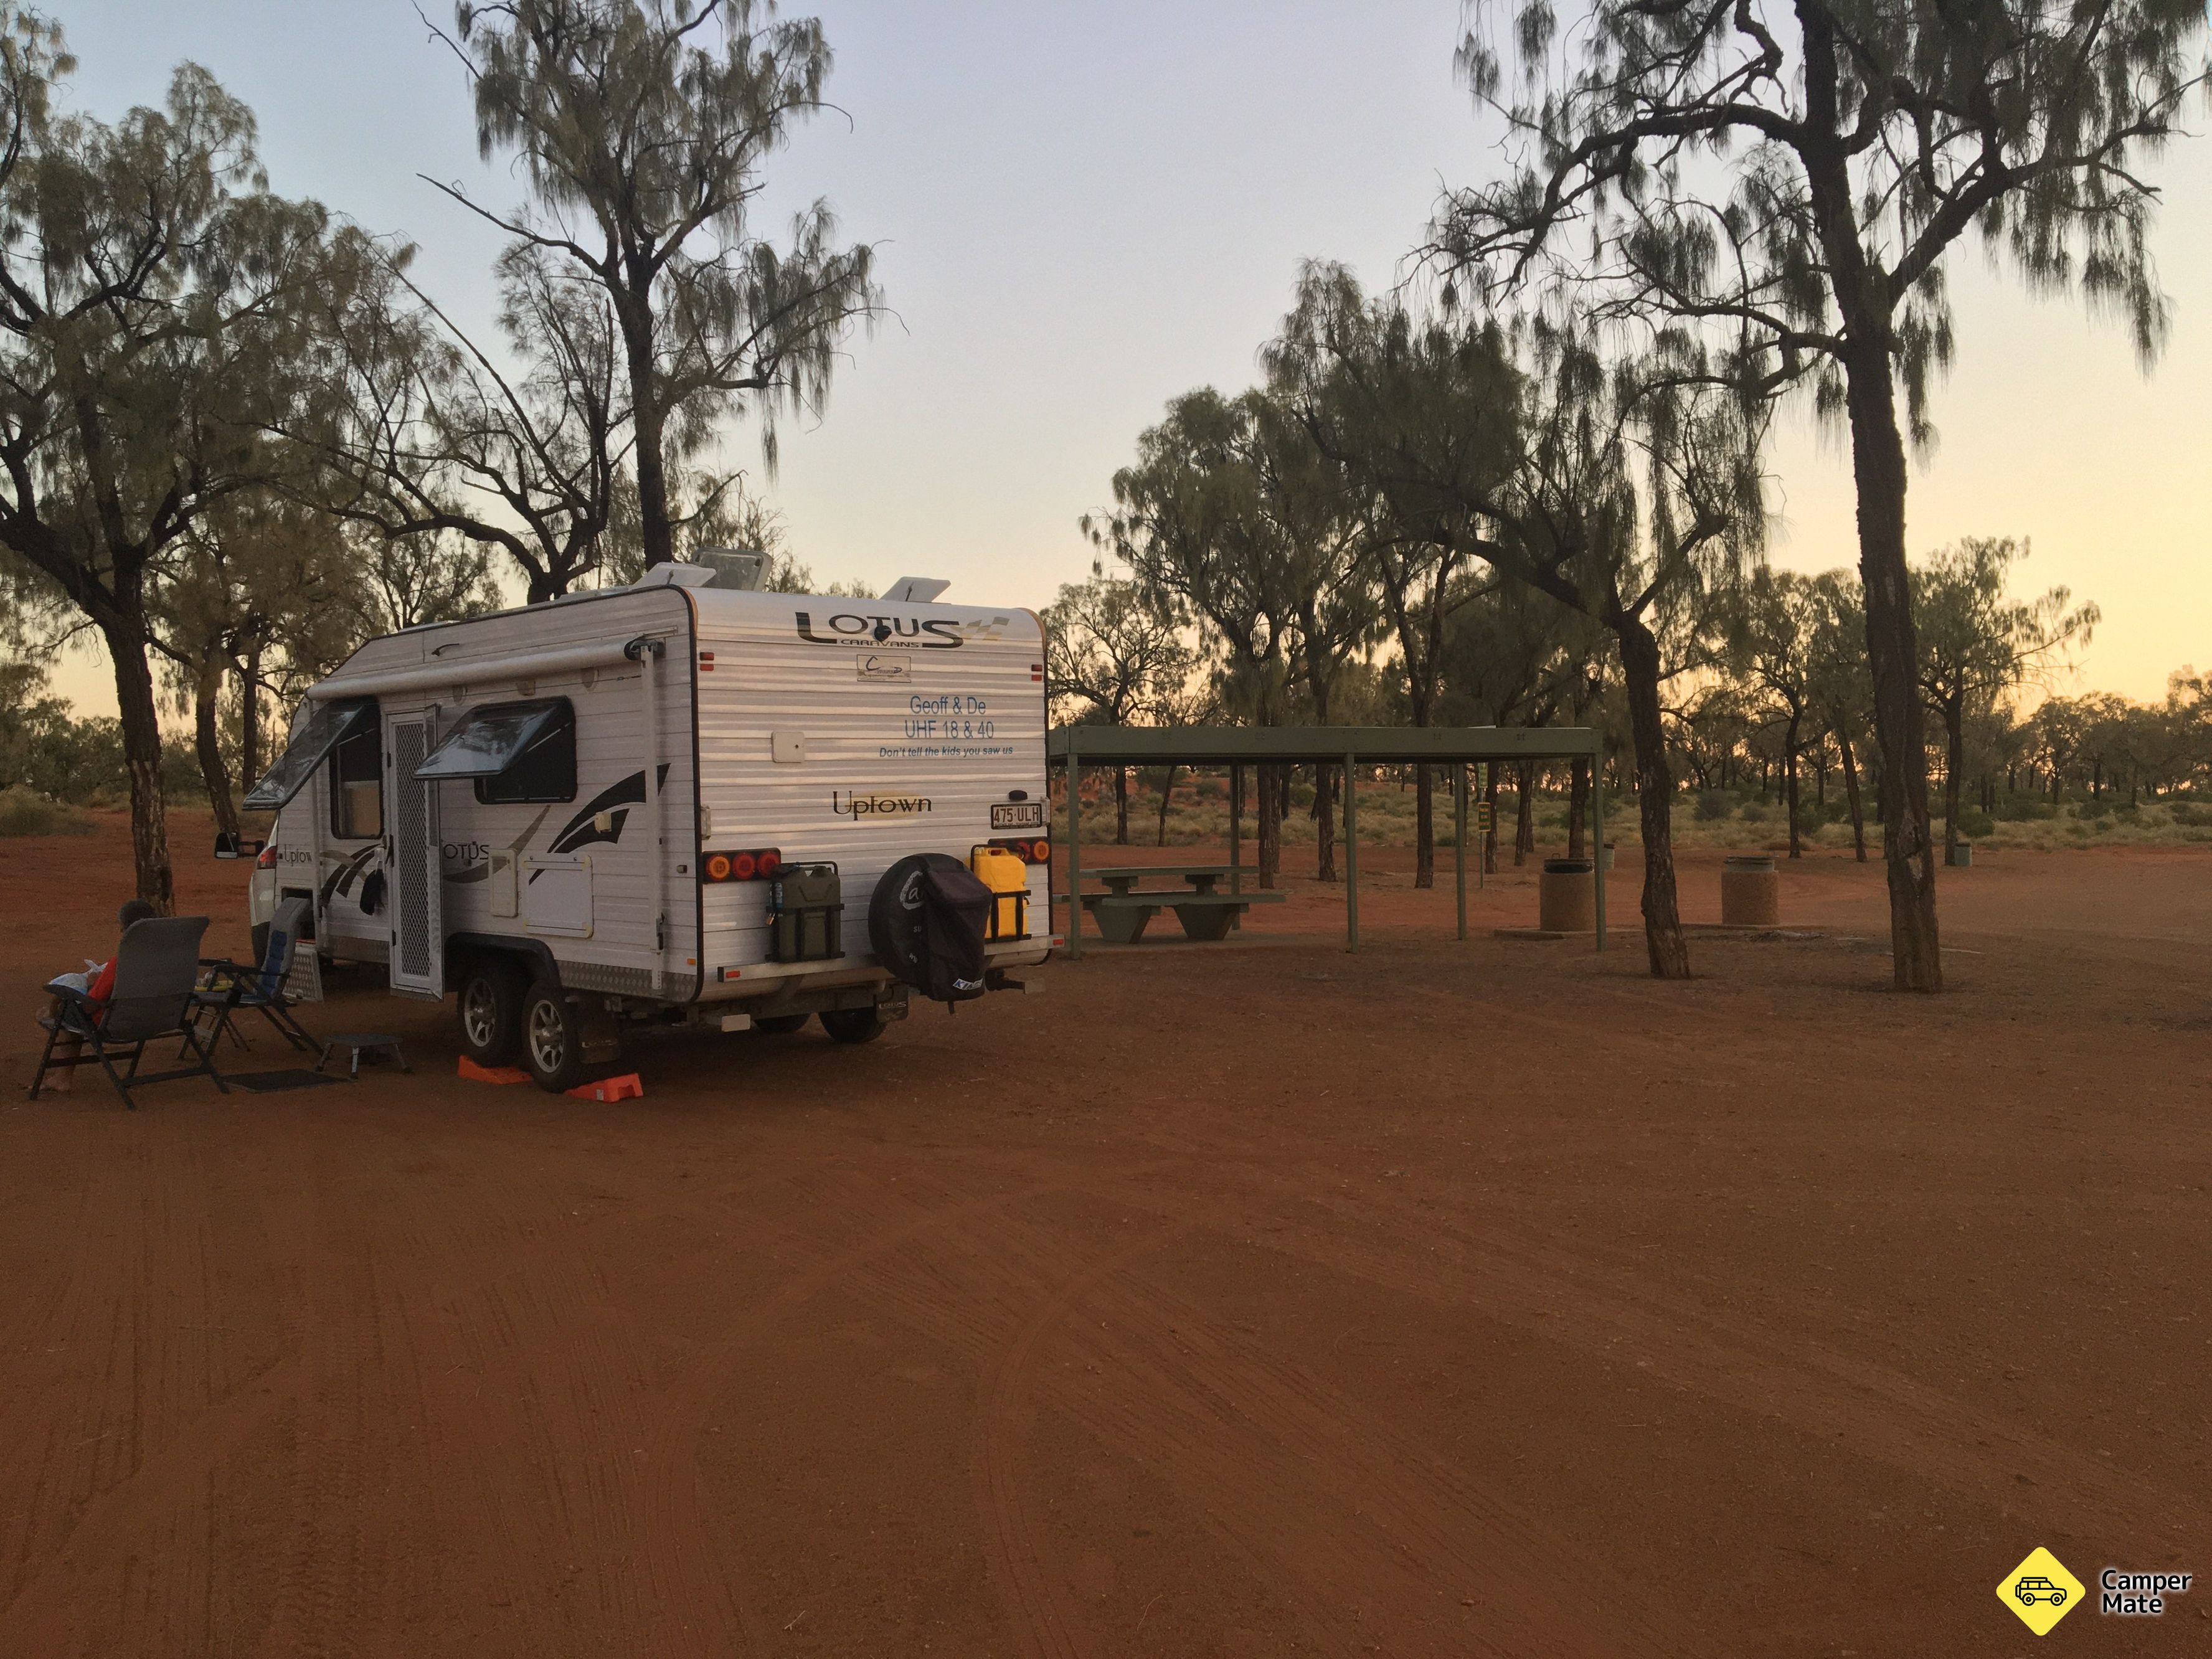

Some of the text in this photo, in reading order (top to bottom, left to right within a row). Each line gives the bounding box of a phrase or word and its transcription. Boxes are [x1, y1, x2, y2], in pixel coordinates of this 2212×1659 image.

[795, 612, 963, 648] LOTUS
[841, 639, 919, 648] CARAVANS
[910, 696, 986, 715] Geoff & De
[905, 720, 995, 739] UHF 18 & 40
[879, 746, 1013, 758] Don't tell the kids you saw us
[833, 790, 932, 821] Uptown
[284, 844, 312, 867] Uptow
[444, 844, 489, 860] OTUS
[899, 870, 924, 910] Ca
